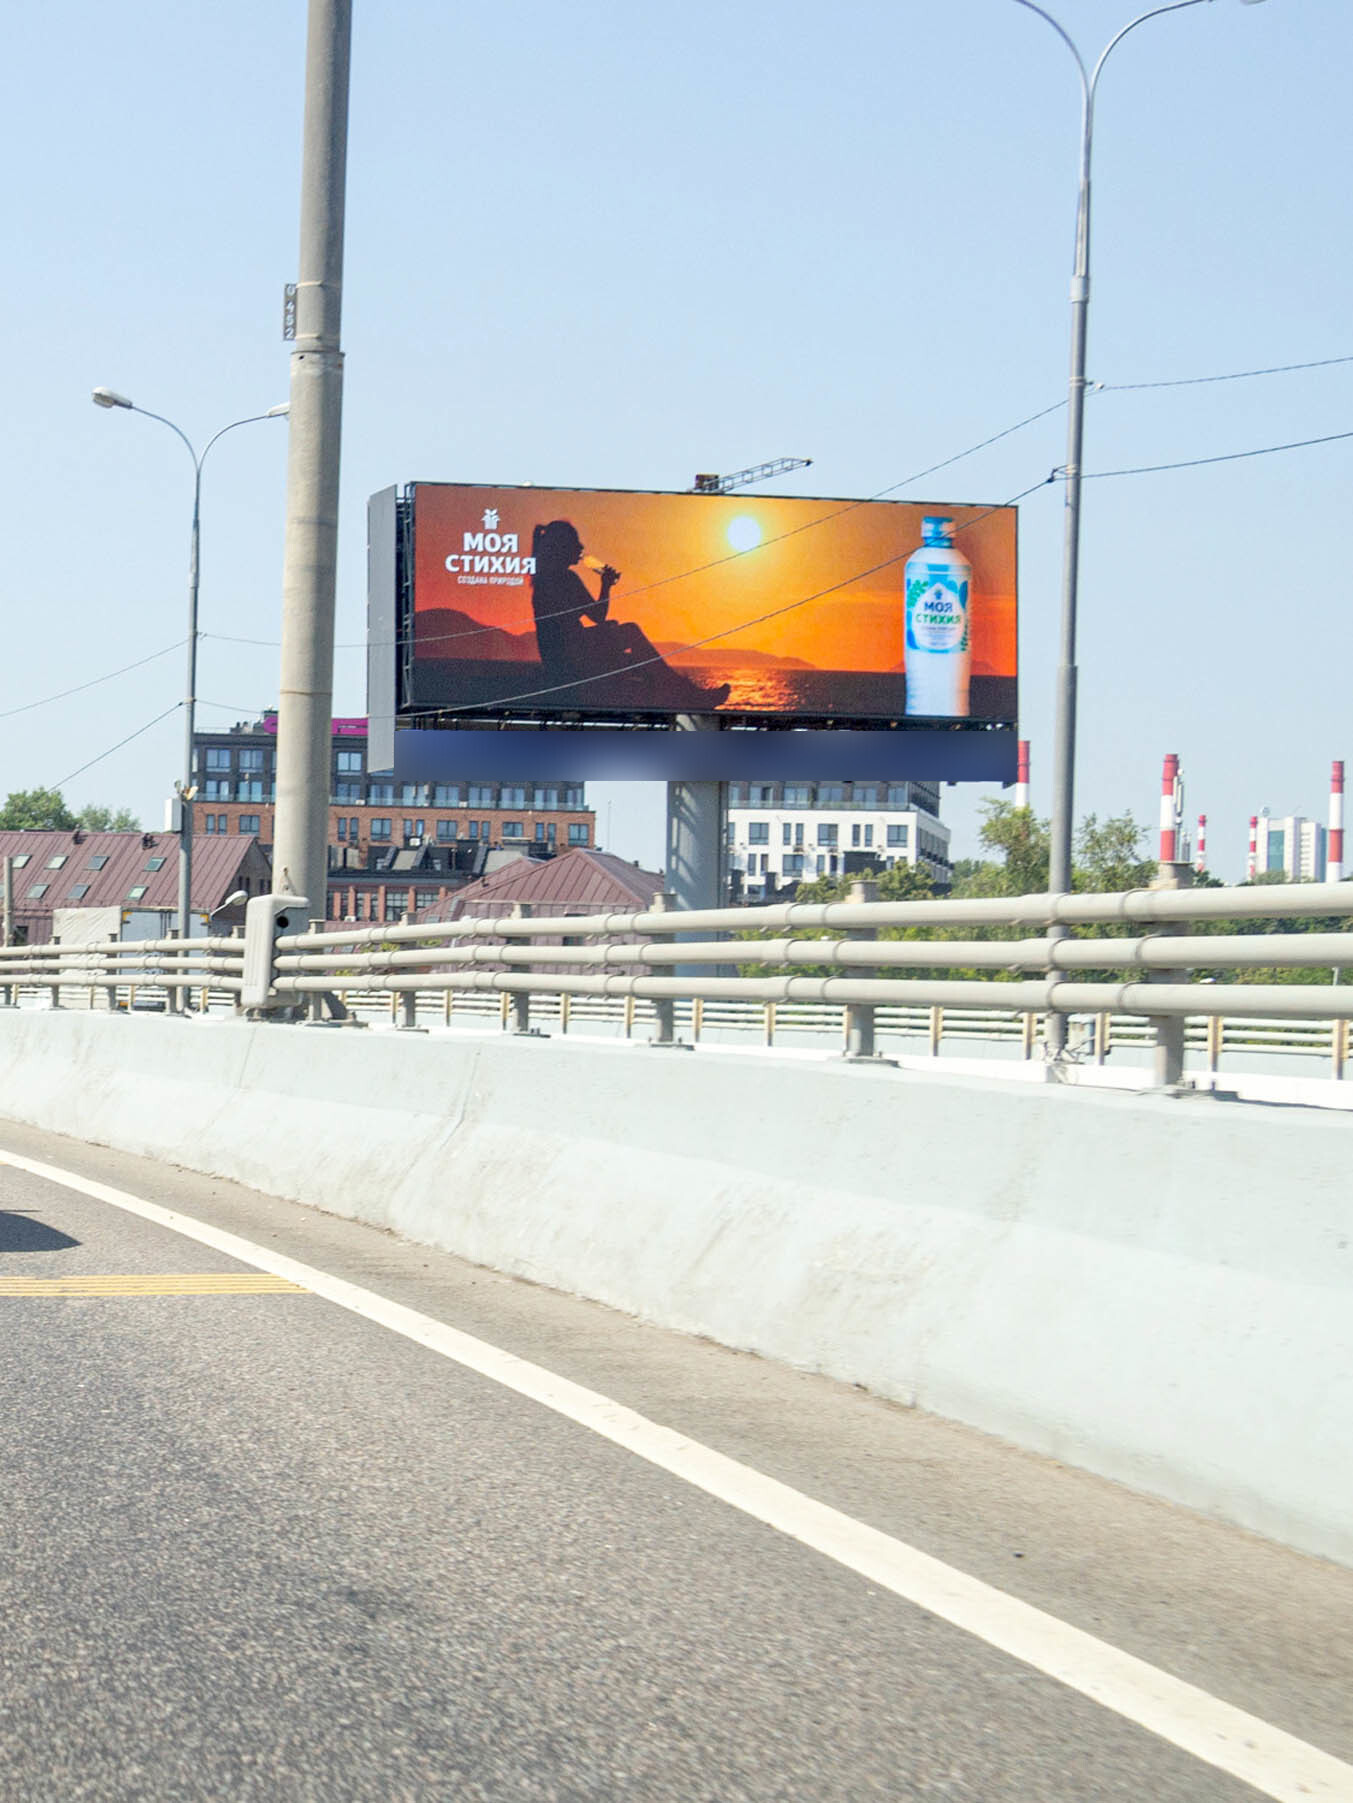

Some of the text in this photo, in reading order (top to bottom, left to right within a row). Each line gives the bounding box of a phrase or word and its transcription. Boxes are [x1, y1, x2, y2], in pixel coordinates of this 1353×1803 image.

[463, 532, 518, 553] МОЯ
[445, 554, 536, 574] СТИХИЯ
[924, 602, 953, 612] МОЯ
